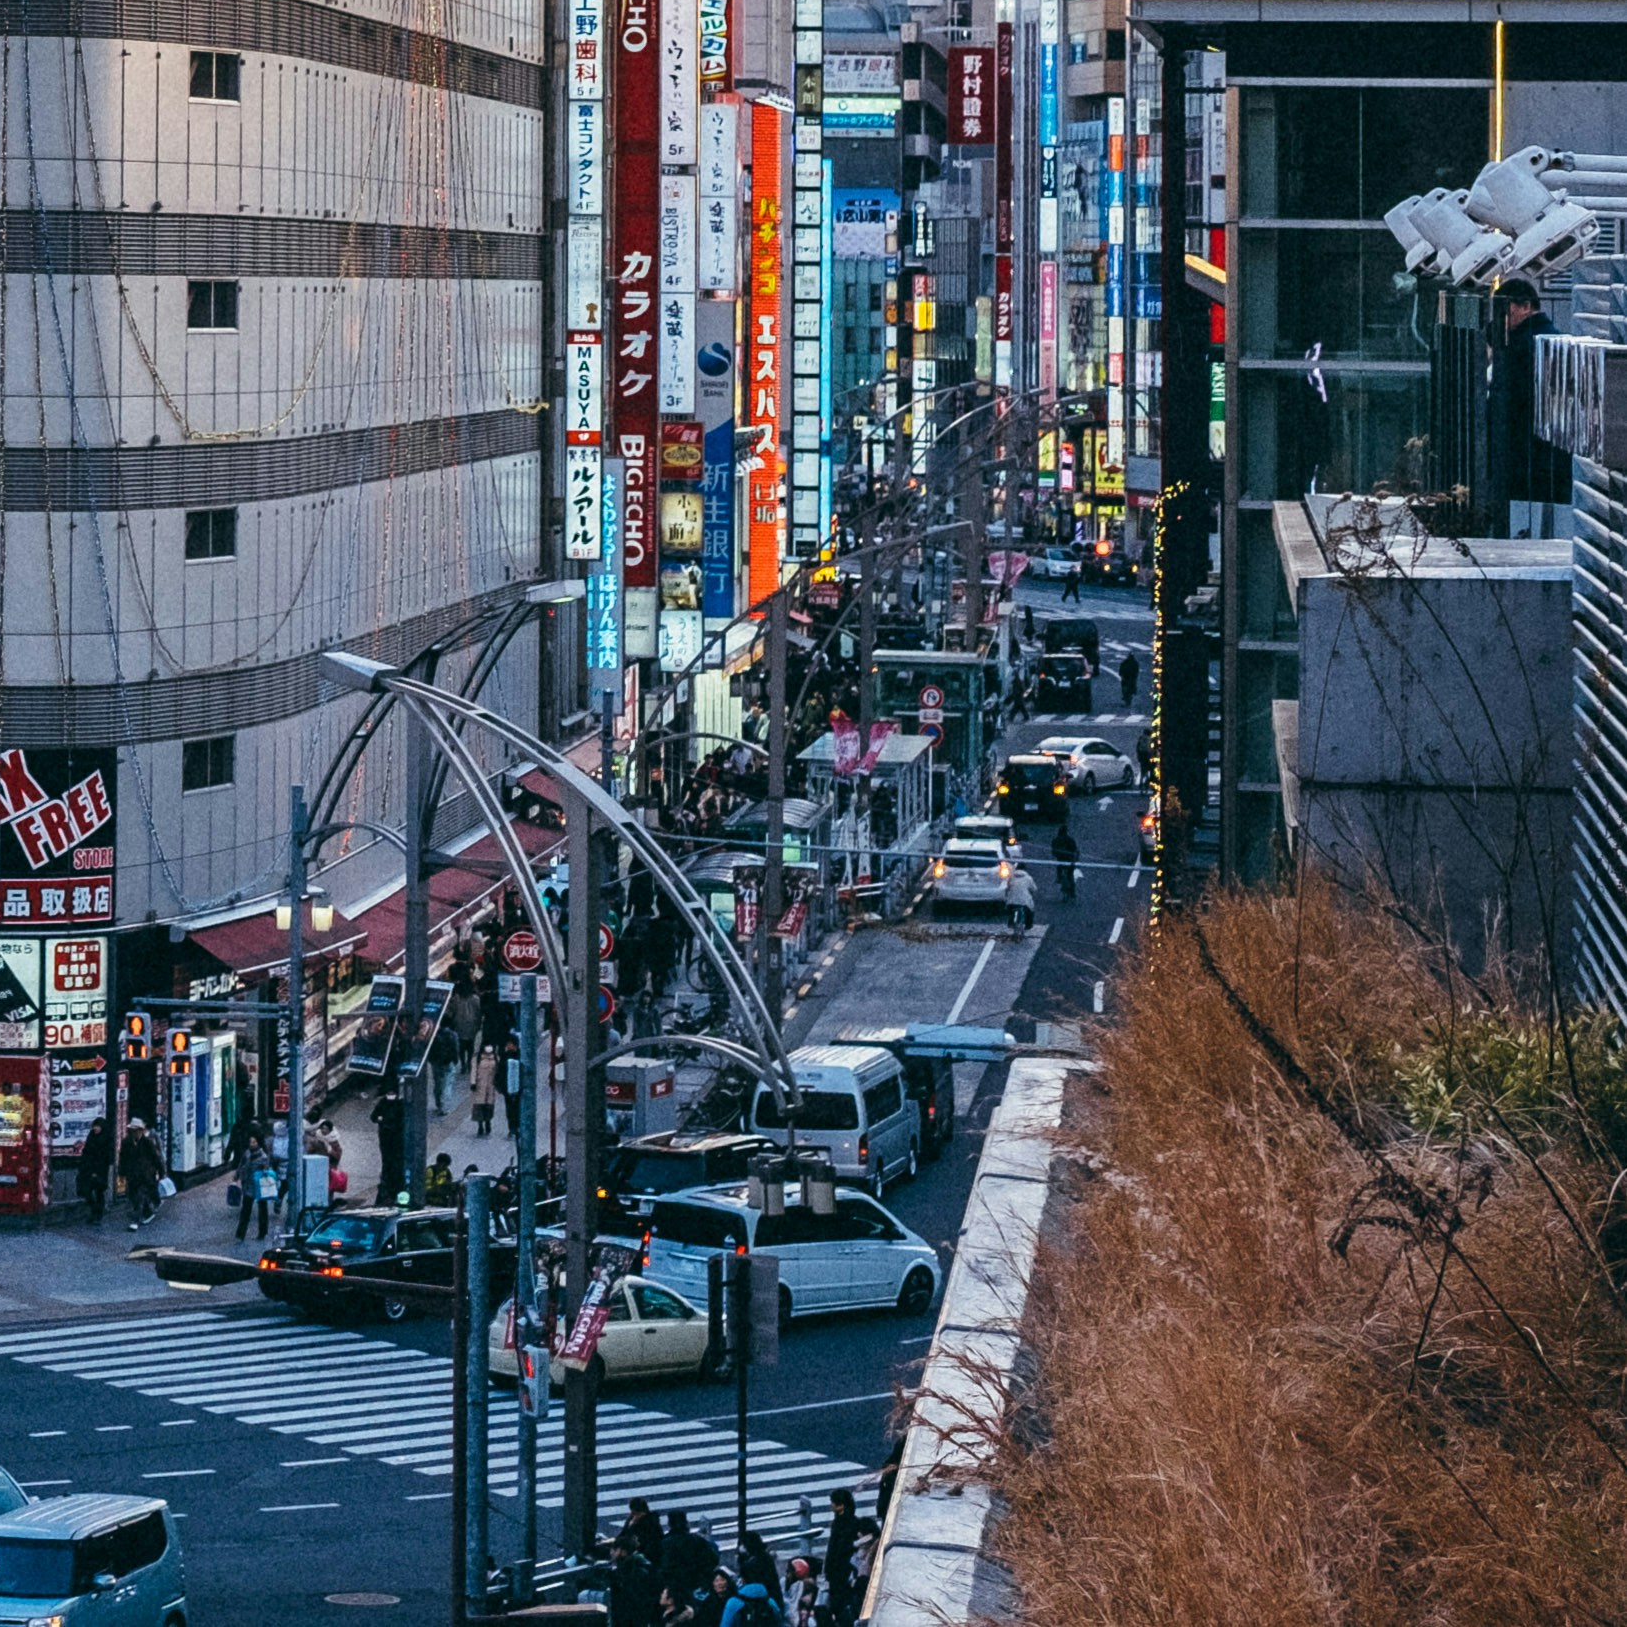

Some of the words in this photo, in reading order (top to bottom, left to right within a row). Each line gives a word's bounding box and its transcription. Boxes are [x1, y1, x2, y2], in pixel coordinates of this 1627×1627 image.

[577, 104, 595, 200] 富士コンタクト
[668, 144, 685, 156] 5F
[575, 201, 594, 210] 4F
[665, 275, 682, 286] 4F
[573, 334, 596, 343] BAG
[619, 251, 653, 397] カラオケ
[998, 291, 1010, 338] カラオケ
[577, 346, 592, 429] MASUYA
[666, 396, 682, 407] 3F
[755, 315, 777, 455] エスパス
[619, 434, 646, 486] BIG
[570, 466, 595, 546] ルノアール
[698, 461, 730, 594] 新生銀行
[10, 769, 113, 871] FREE
[72, 846, 114, 870] STORE
[508, 943, 541, 959] 消火栓
[3, 1004, 36, 1022] VISA
[276, 1010, 291, 1078] ルチメディア
